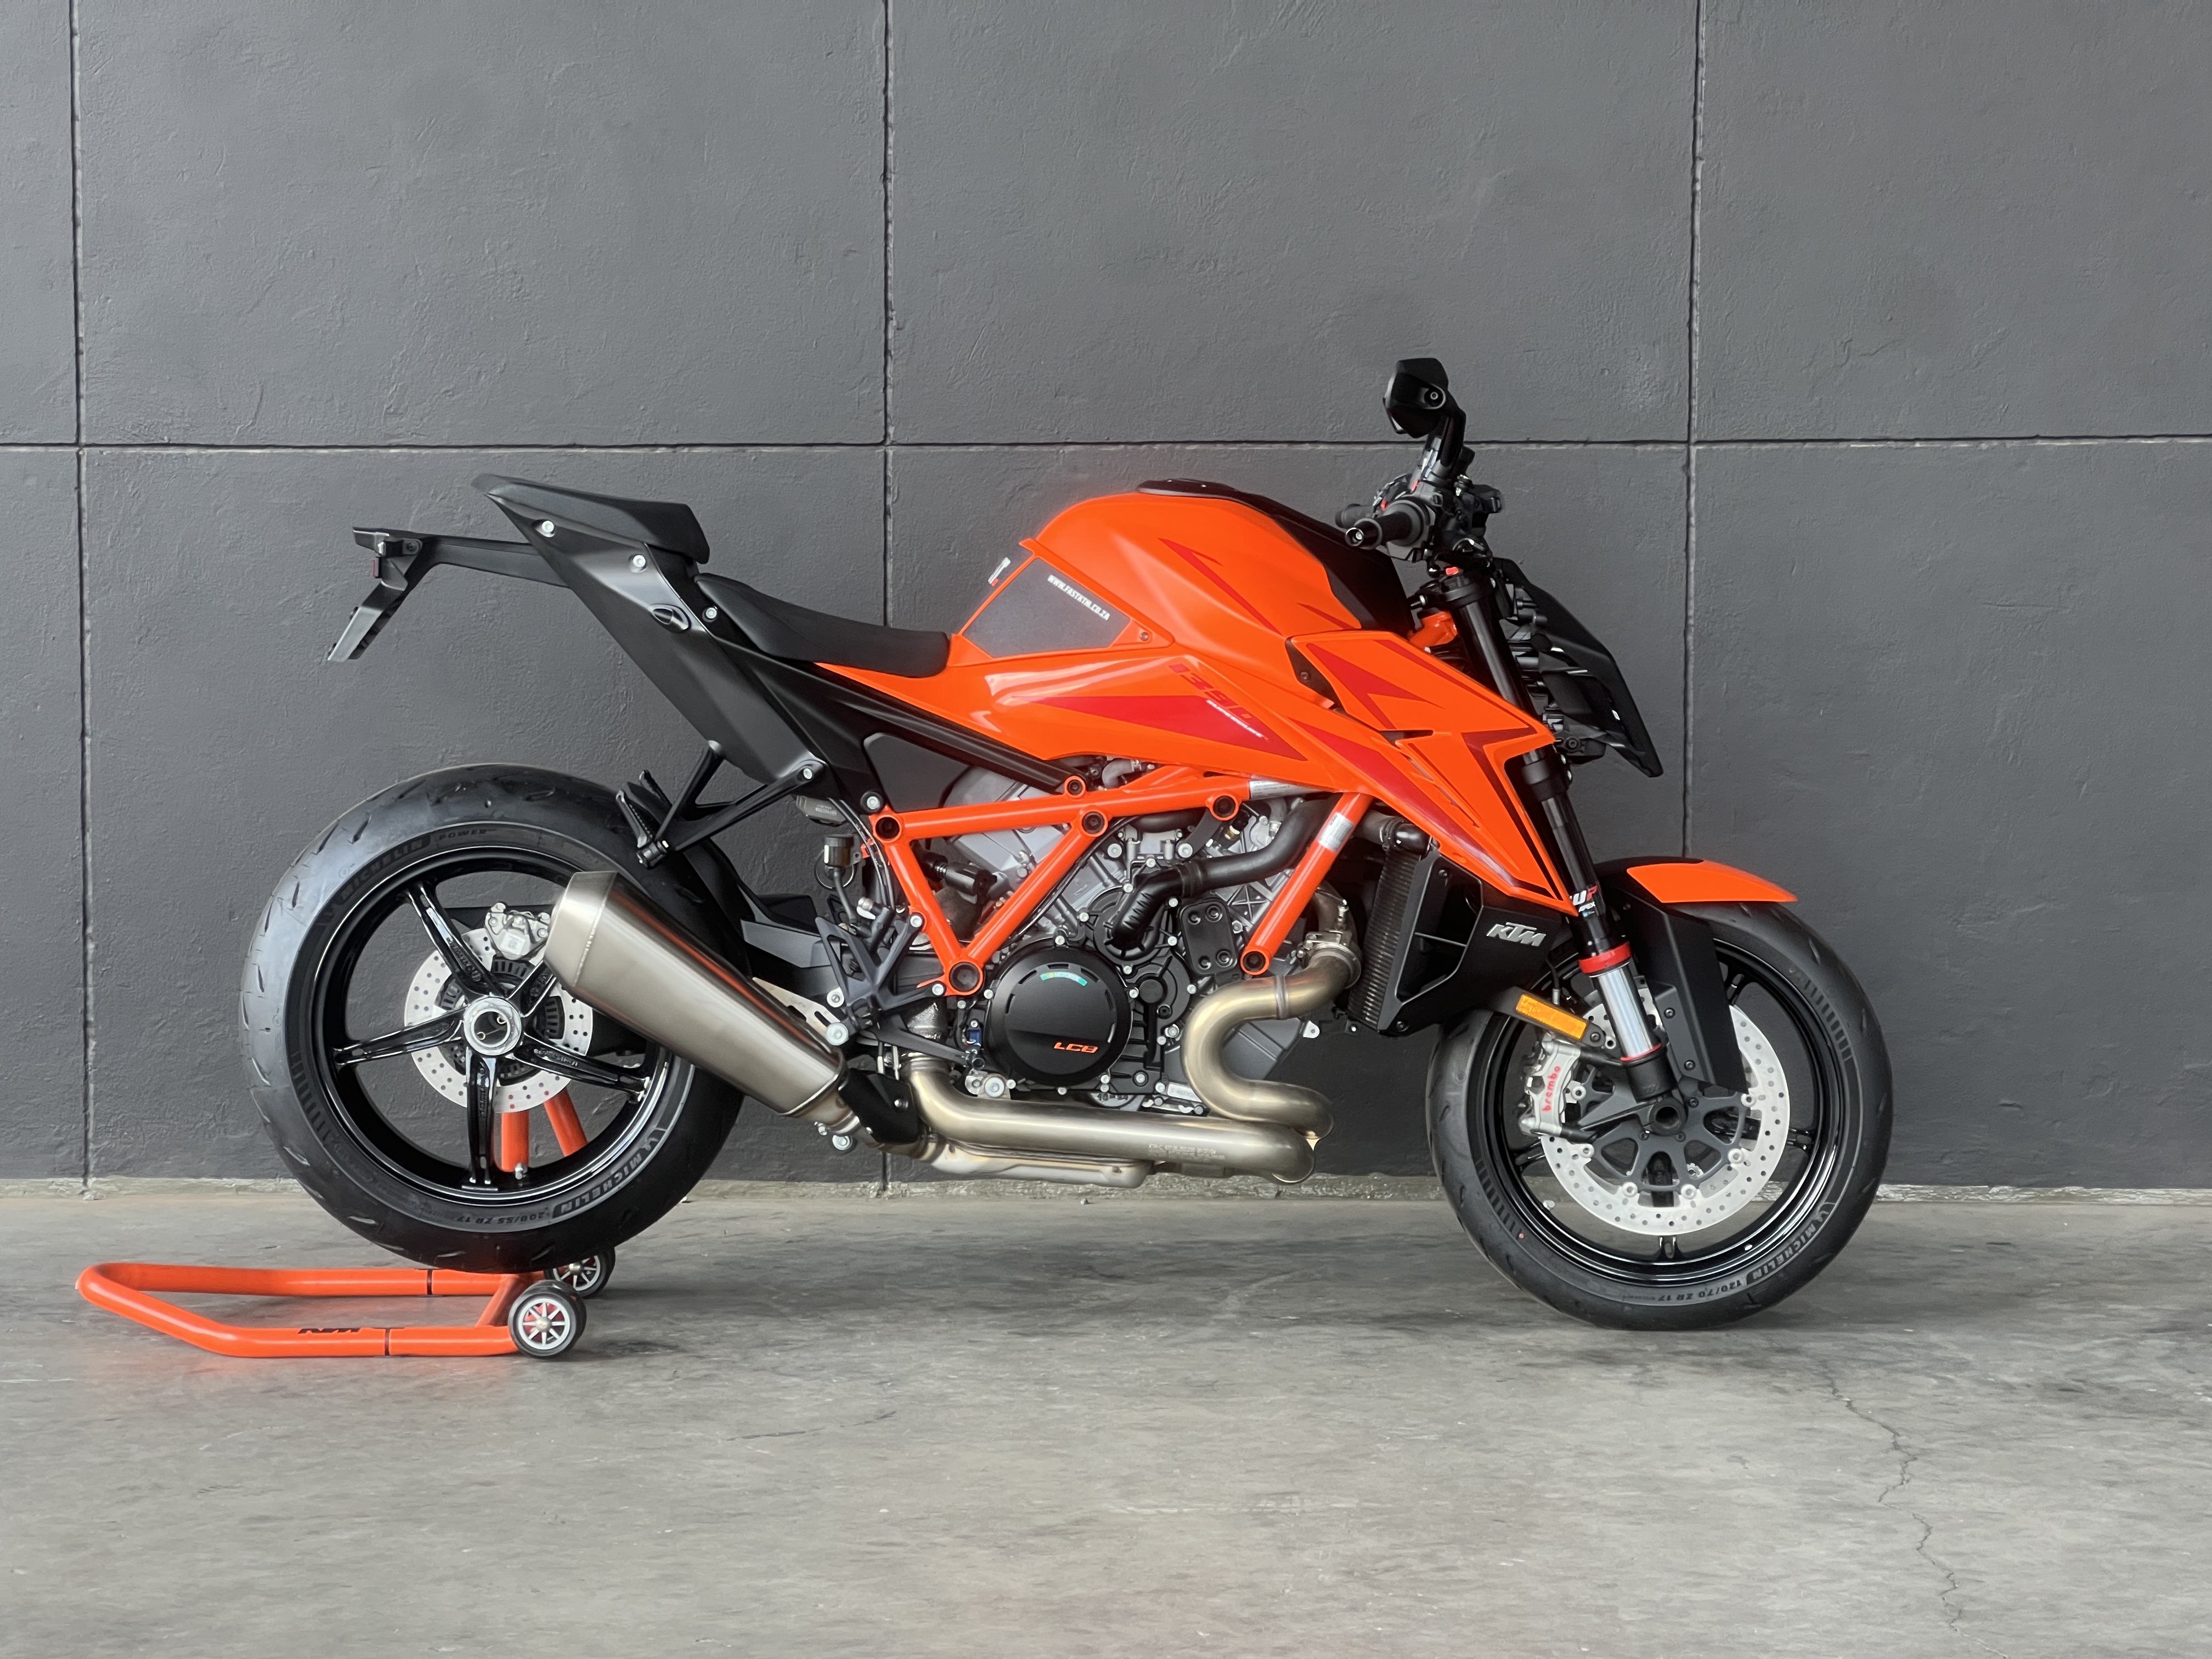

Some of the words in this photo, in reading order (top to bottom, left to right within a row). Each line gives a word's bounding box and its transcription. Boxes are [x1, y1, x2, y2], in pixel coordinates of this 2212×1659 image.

[439, 829, 487, 840] POWER
[1486, 922, 1547, 947] KTM
[1054, 1042, 1098, 1053] LC8
[1541, 1066, 1561, 1111] brembo
[561, 1153, 642, 1214] MICHELIN
[497, 1211, 545, 1224] 200/55
[1752, 1223, 1816, 1279] MICHELIN
[1699, 1279, 1742, 1298] 120/70
